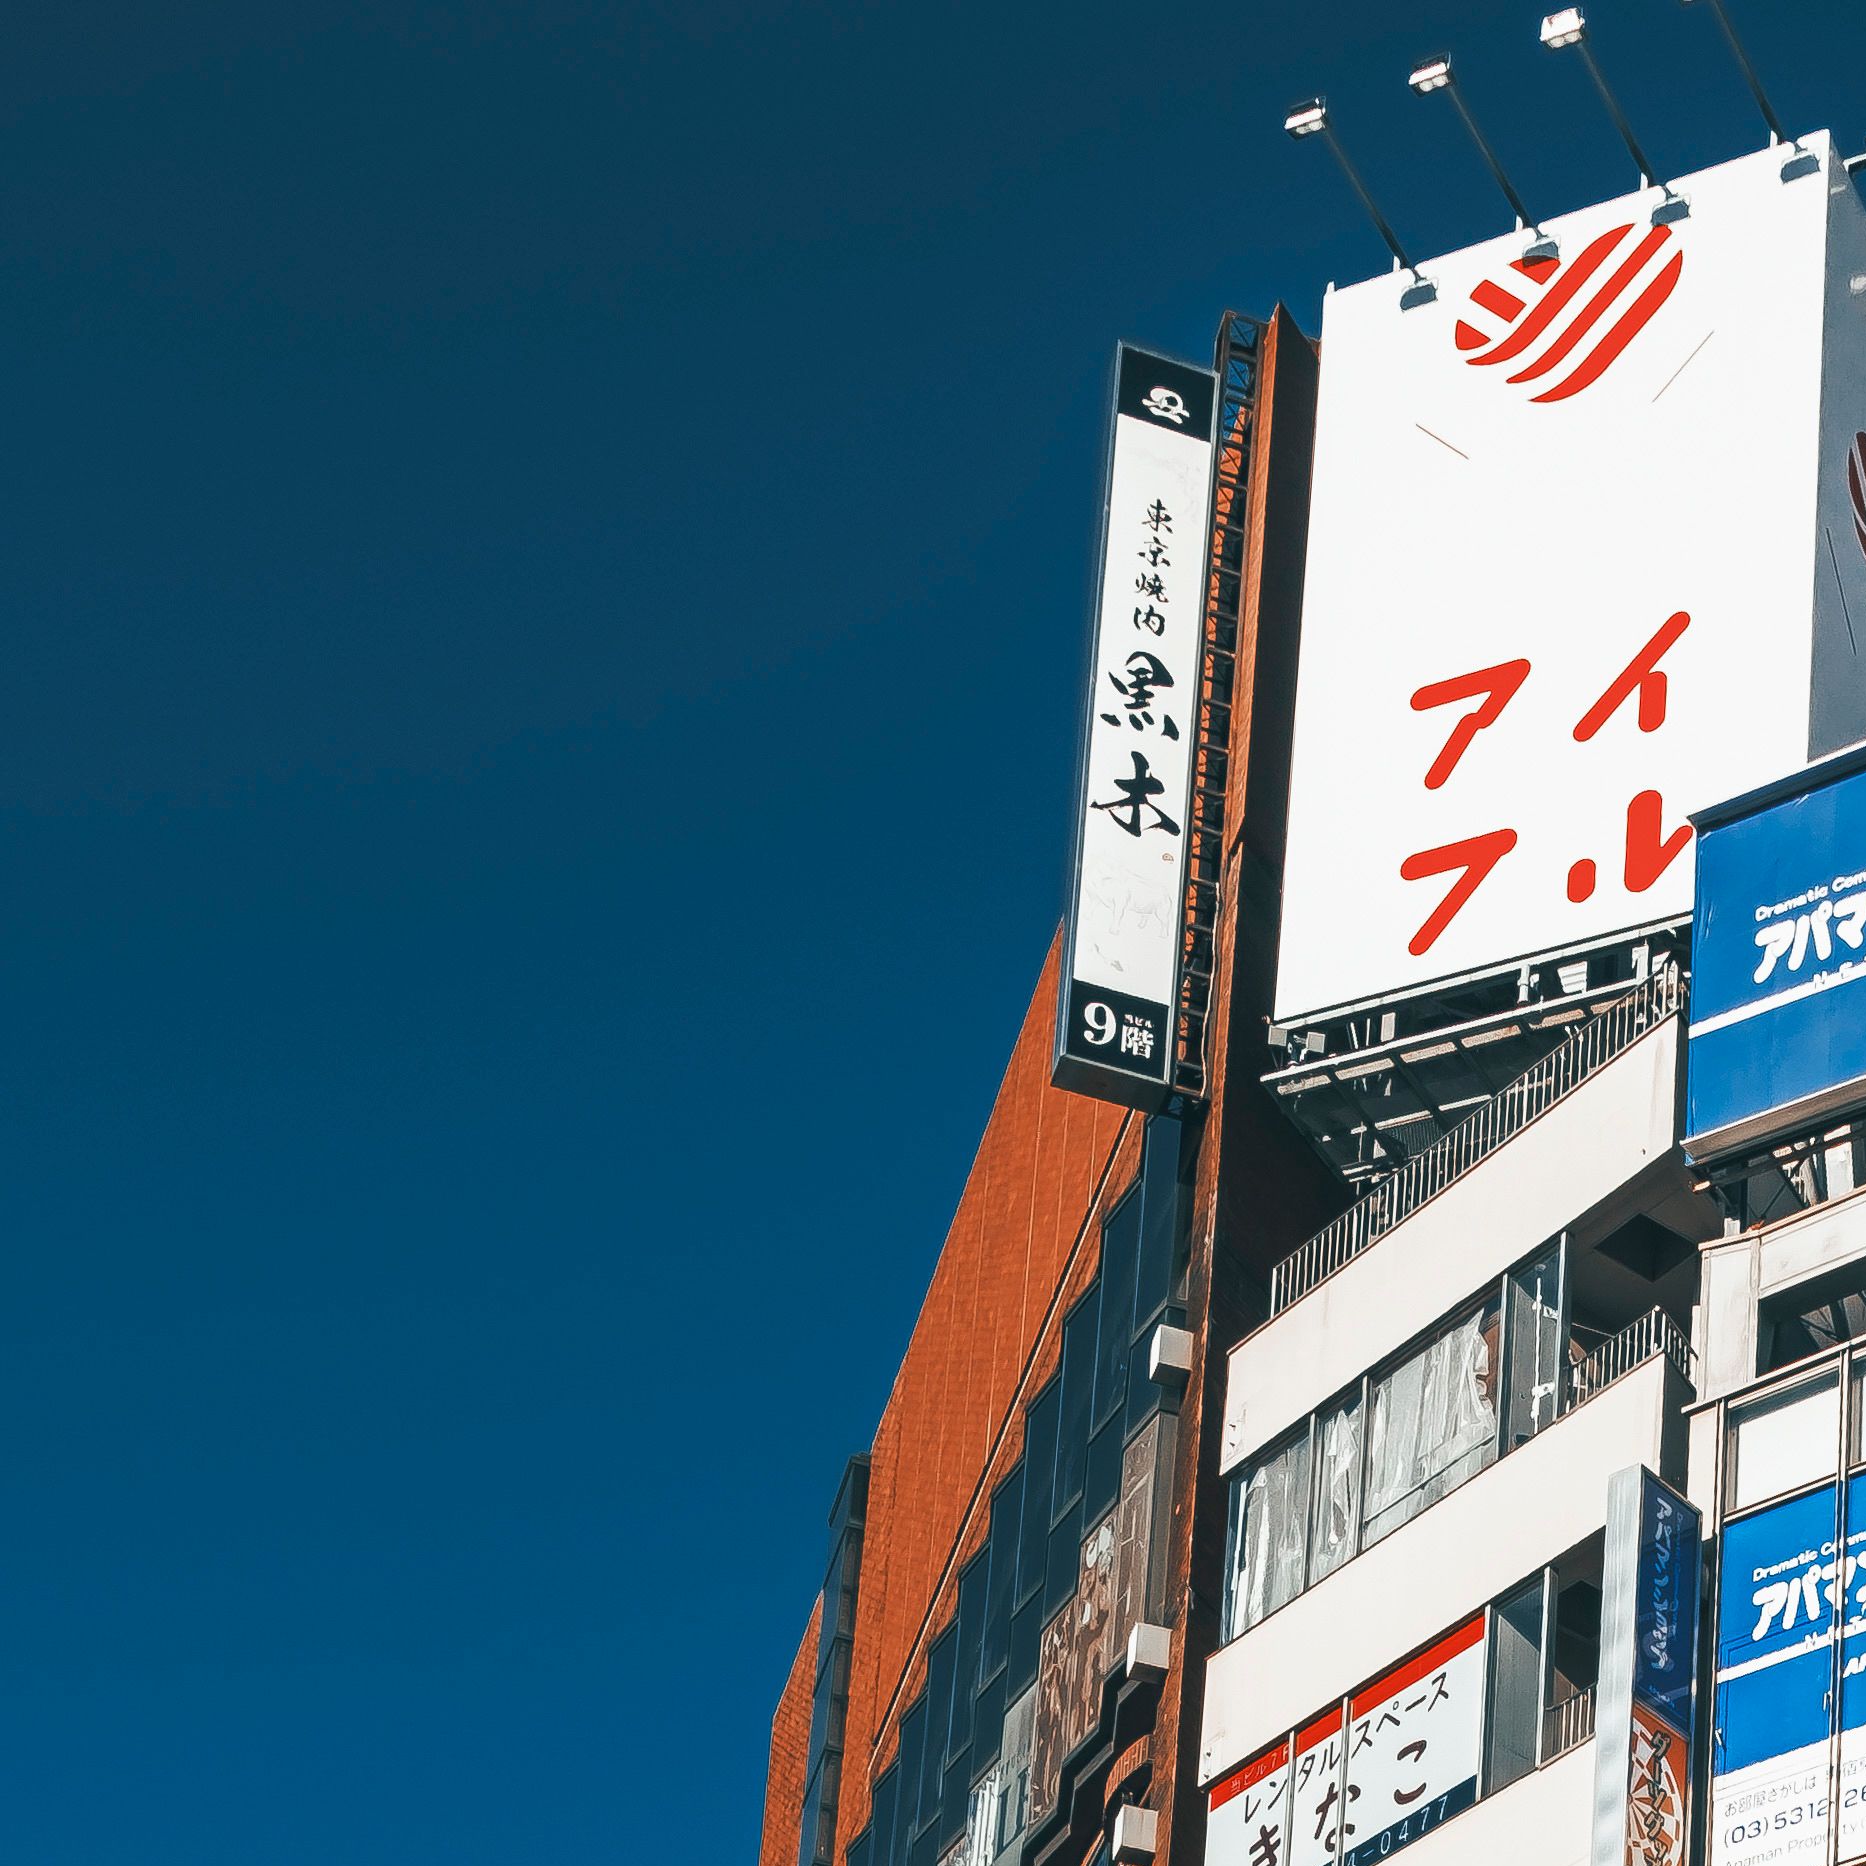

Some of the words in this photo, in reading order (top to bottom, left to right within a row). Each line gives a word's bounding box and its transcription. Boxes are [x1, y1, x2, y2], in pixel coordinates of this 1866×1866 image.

[1090, 651, 1180, 837] 黒木
[1754, 882, 1830, 920] Dramatic
[1244, 1670, 1451, 1825] レンタルスペース
